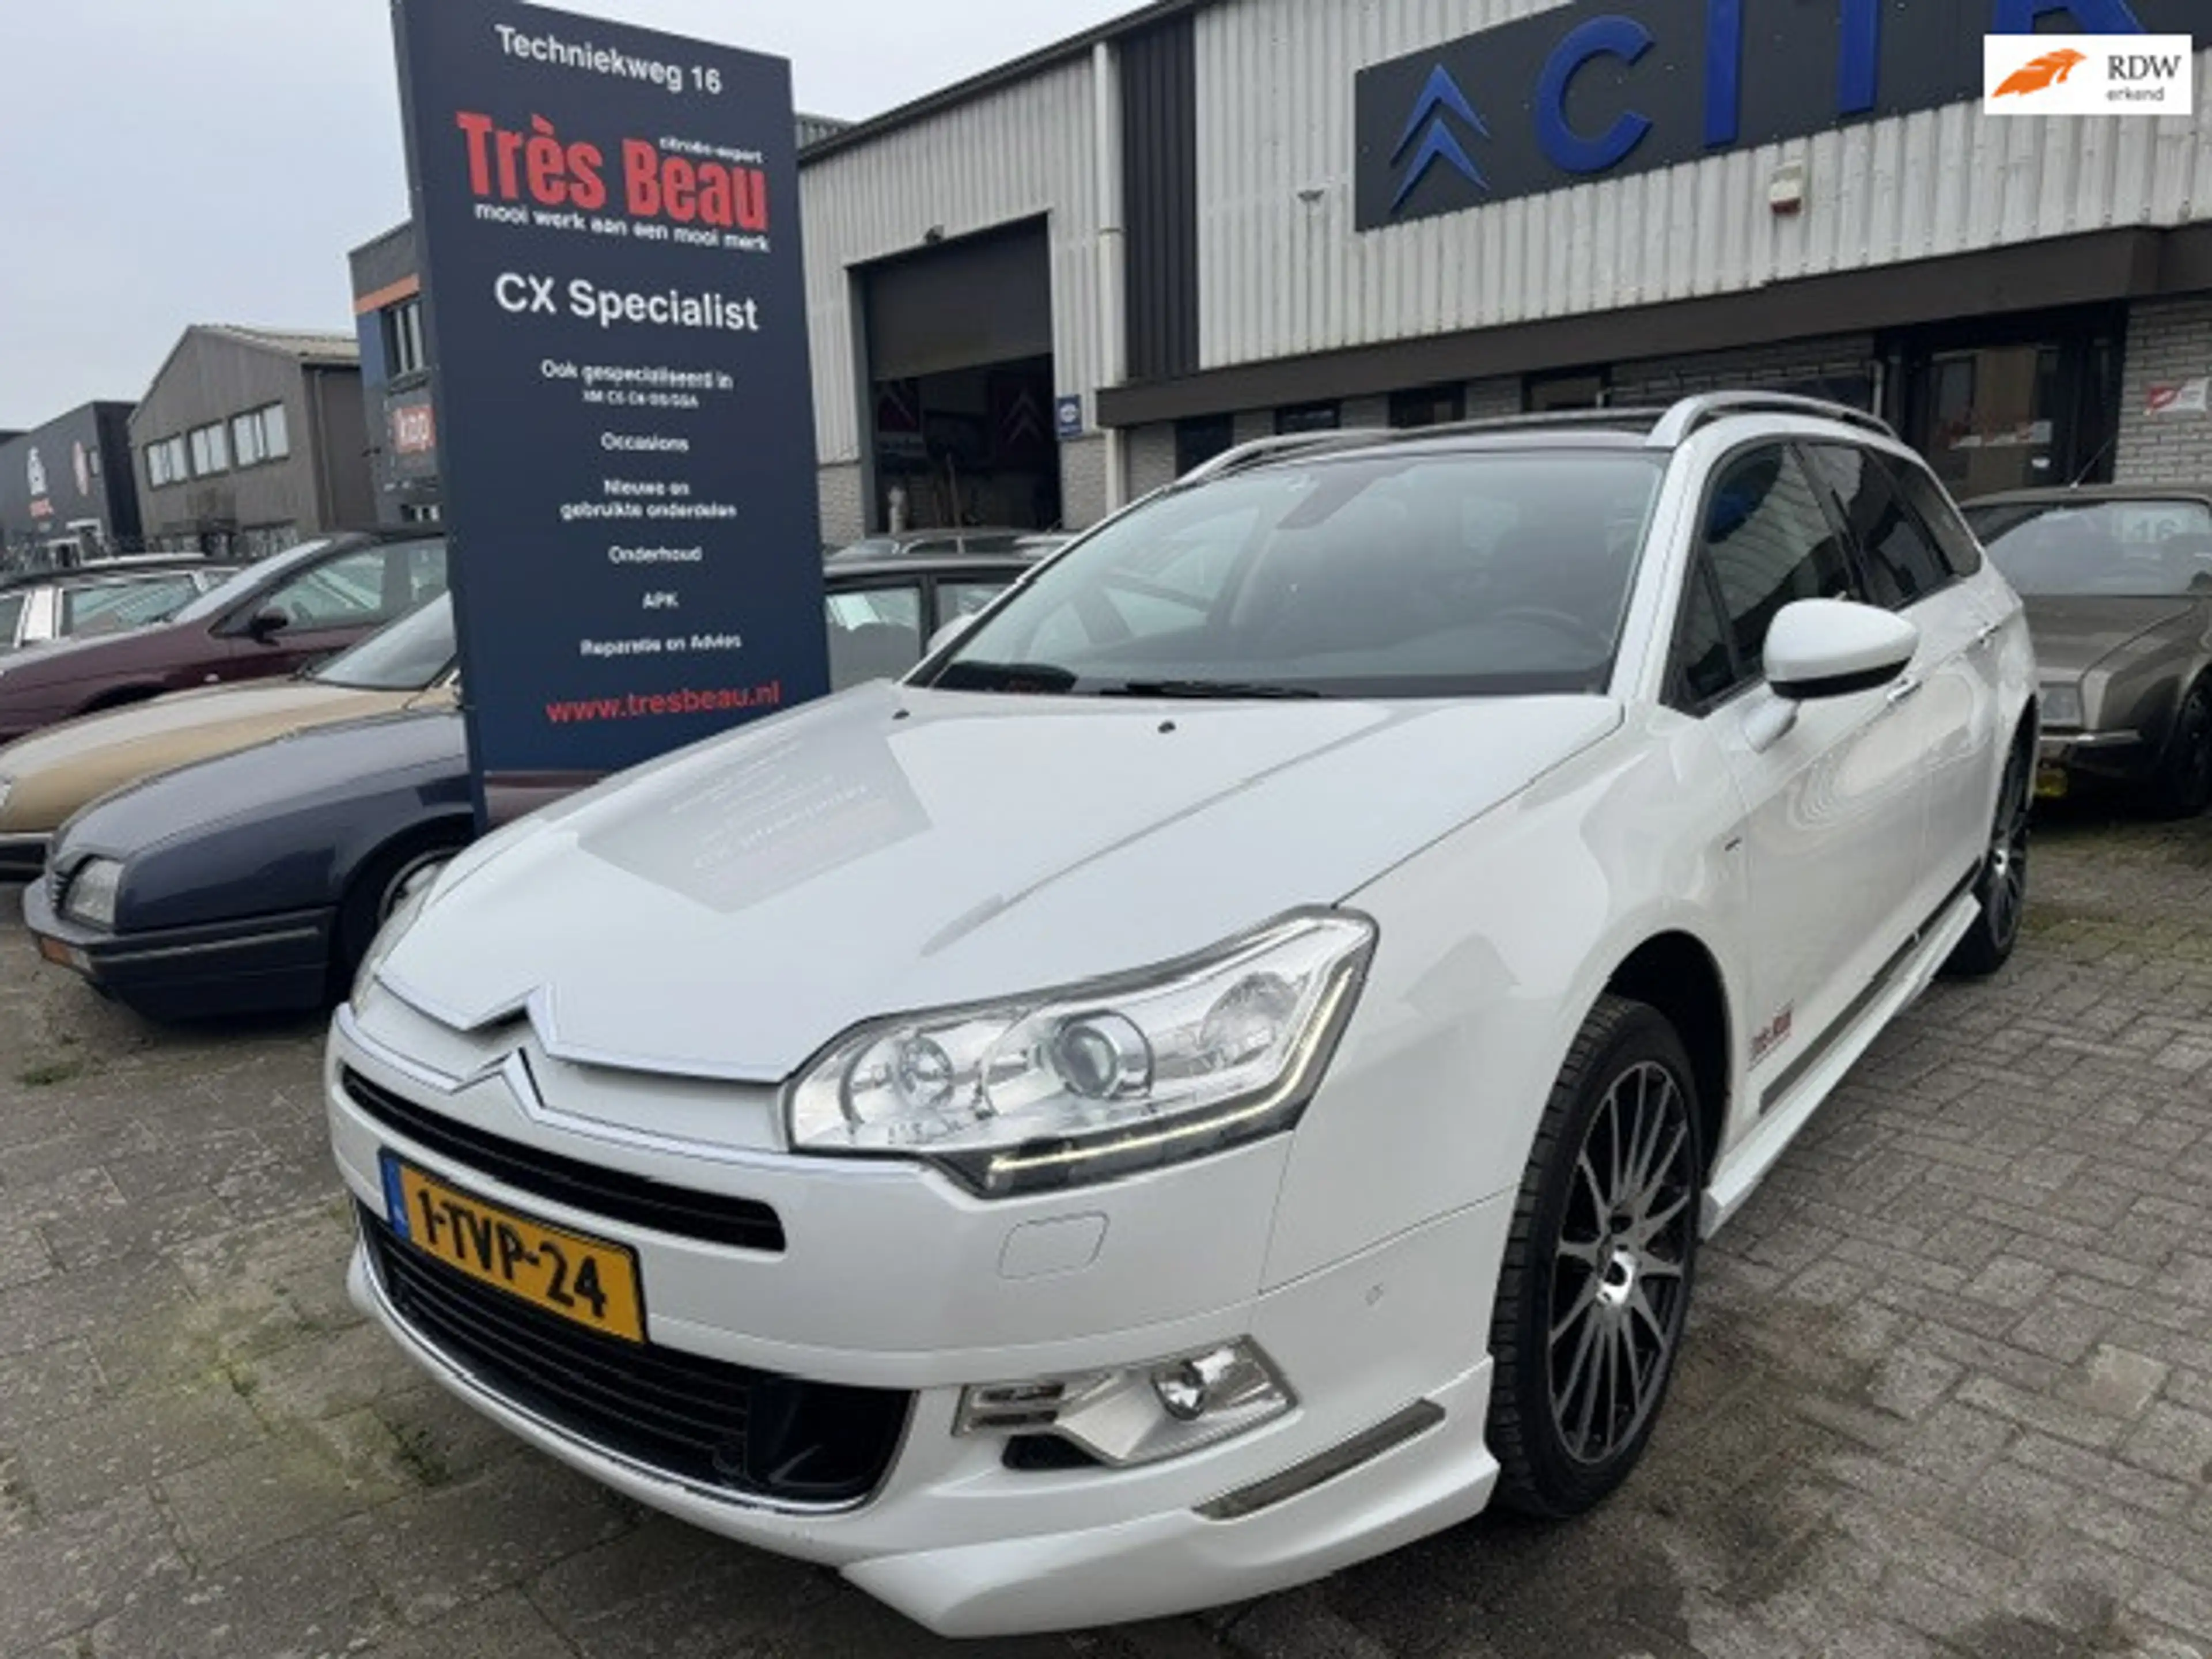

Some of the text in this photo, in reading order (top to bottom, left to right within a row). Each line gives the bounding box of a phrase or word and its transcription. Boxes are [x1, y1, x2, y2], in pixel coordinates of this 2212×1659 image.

[494, 24, 723, 94] Techniekweg 16
[456, 111, 770, 230] Très Beau
[474, 202, 771, 252] mooi werk aan een mooi merk
[494, 272, 760, 331] CX Specialist
[541, 358, 734, 390] Ook gespecialiseerd in
[601, 431, 689, 453] Occasions
[604, 479, 690, 496] Nieuwe en
[559, 501, 737, 521] gebruikte onderdelen
[608, 546, 702, 564] Onderhoud
[642, 591, 680, 609] APK
[580, 632, 742, 657] Reparatie en Advies
[547, 680, 780, 723] www.tresbeau.nl
[416, 1187, 607, 1319] 1-TVP-24
